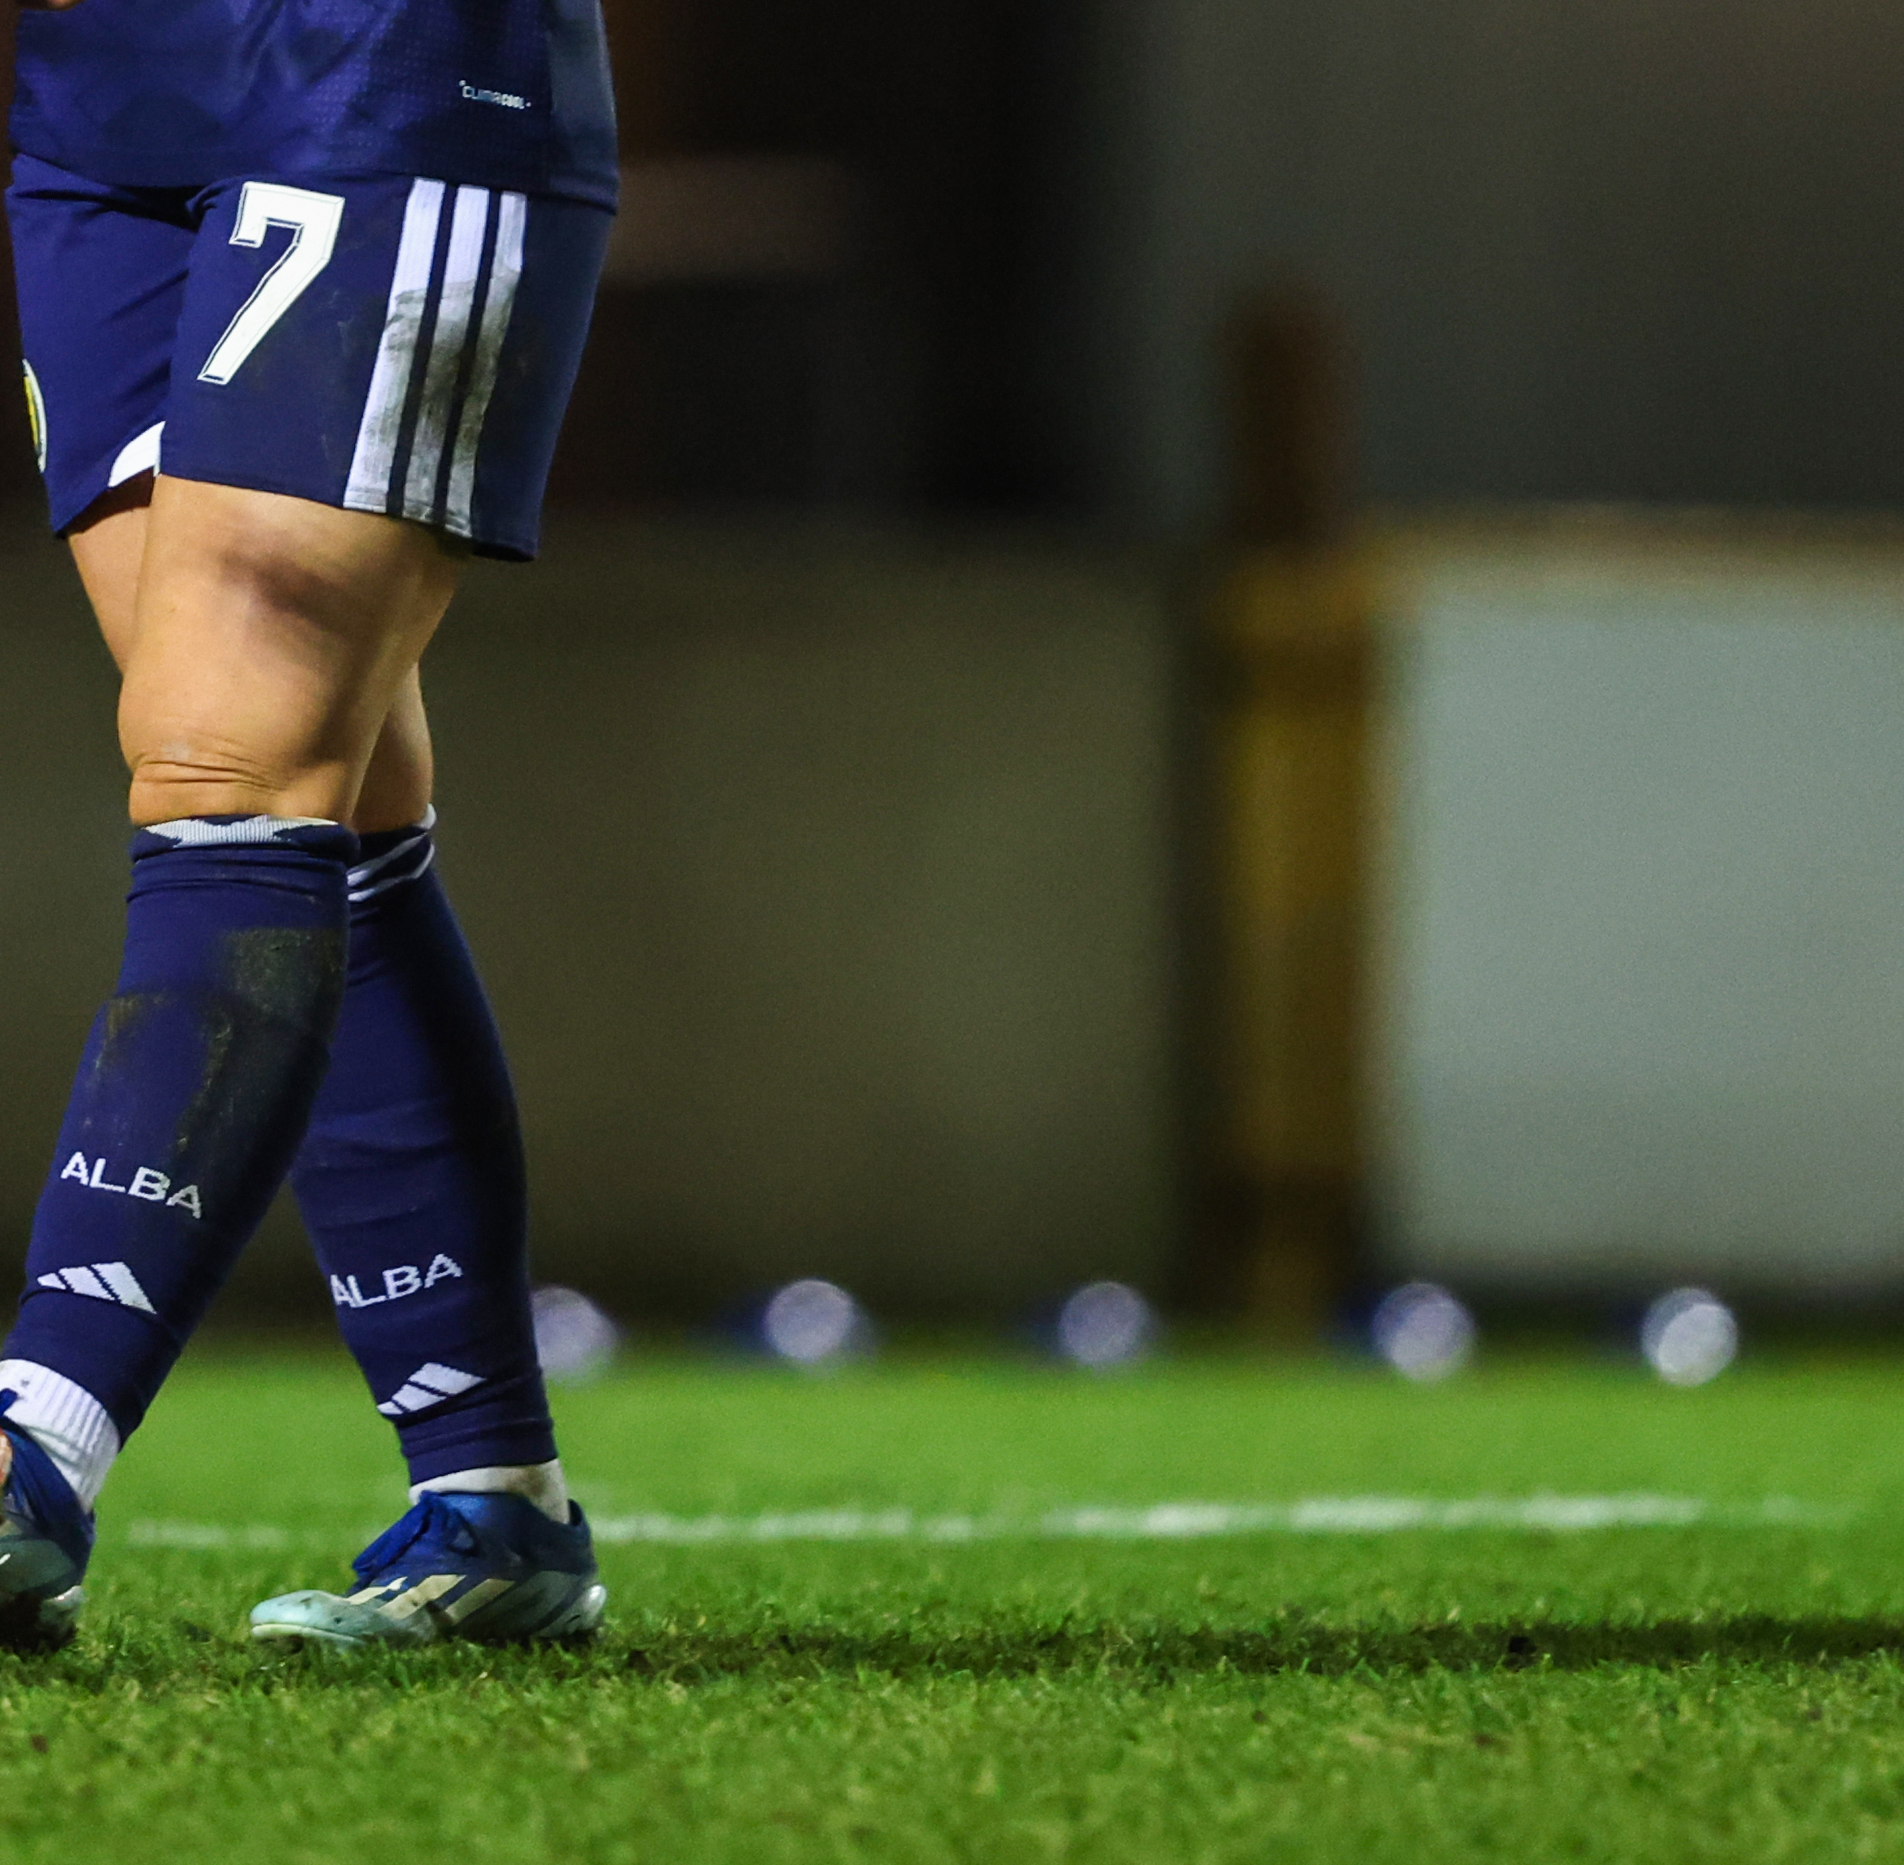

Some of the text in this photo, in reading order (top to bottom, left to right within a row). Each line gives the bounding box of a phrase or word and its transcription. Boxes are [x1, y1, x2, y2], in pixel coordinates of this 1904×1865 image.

[197, 181, 346, 385] 7
[60, 1151, 205, 1219] ALBA
[329, 1252, 464, 1309] ALBA
